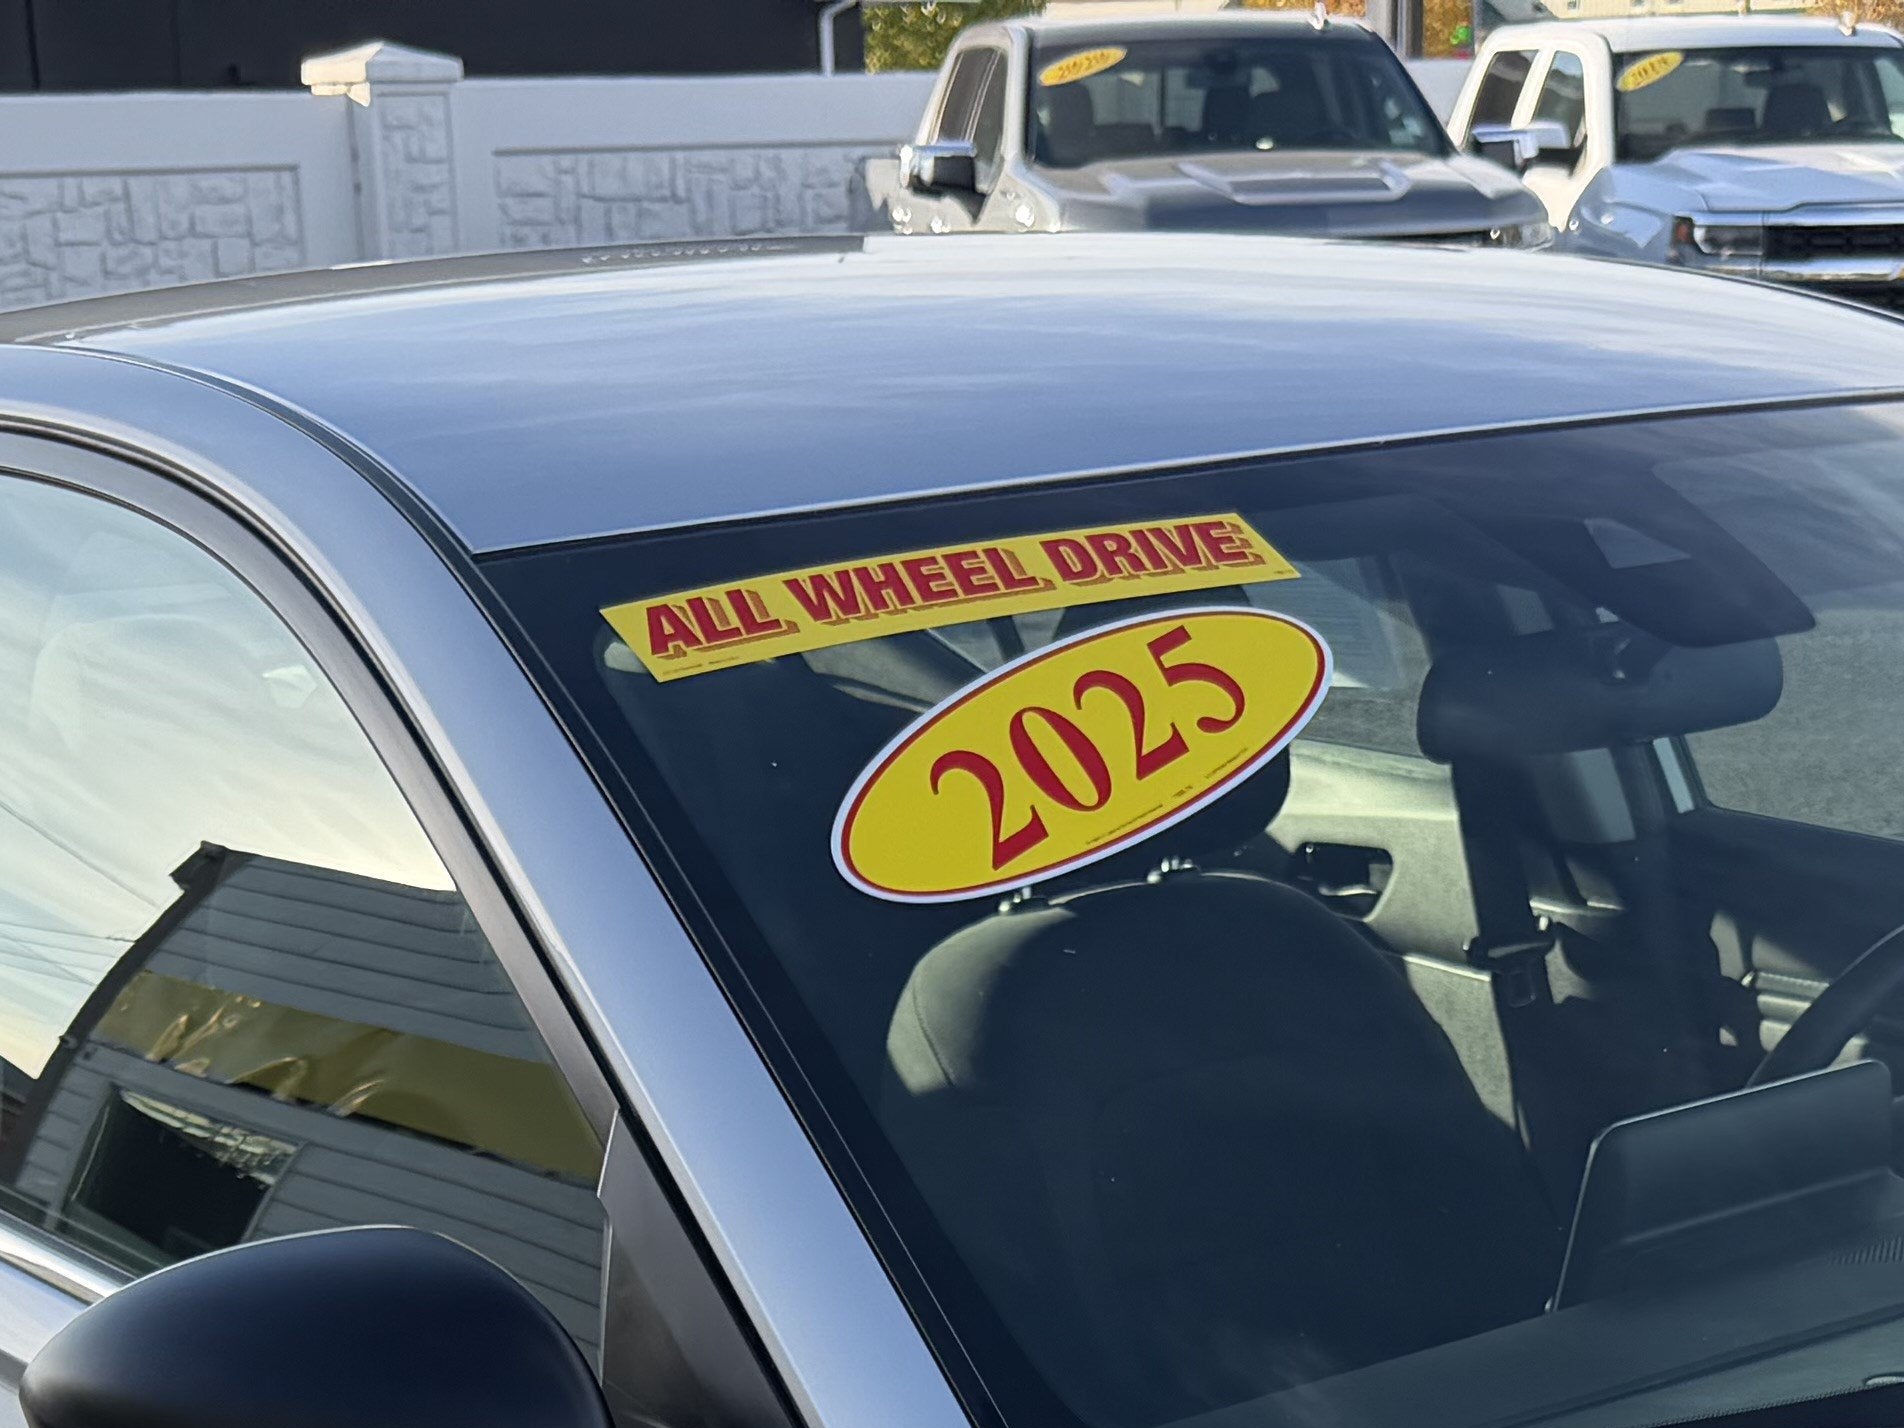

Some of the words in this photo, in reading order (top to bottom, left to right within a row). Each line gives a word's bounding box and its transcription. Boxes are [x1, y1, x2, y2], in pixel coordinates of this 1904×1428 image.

[645, 588, 800, 660] ALL
[783, 547, 1057, 626] WHEEL
[1039, 520, 1266, 587] DRIVE
[930, 625, 1245, 870] 2025
